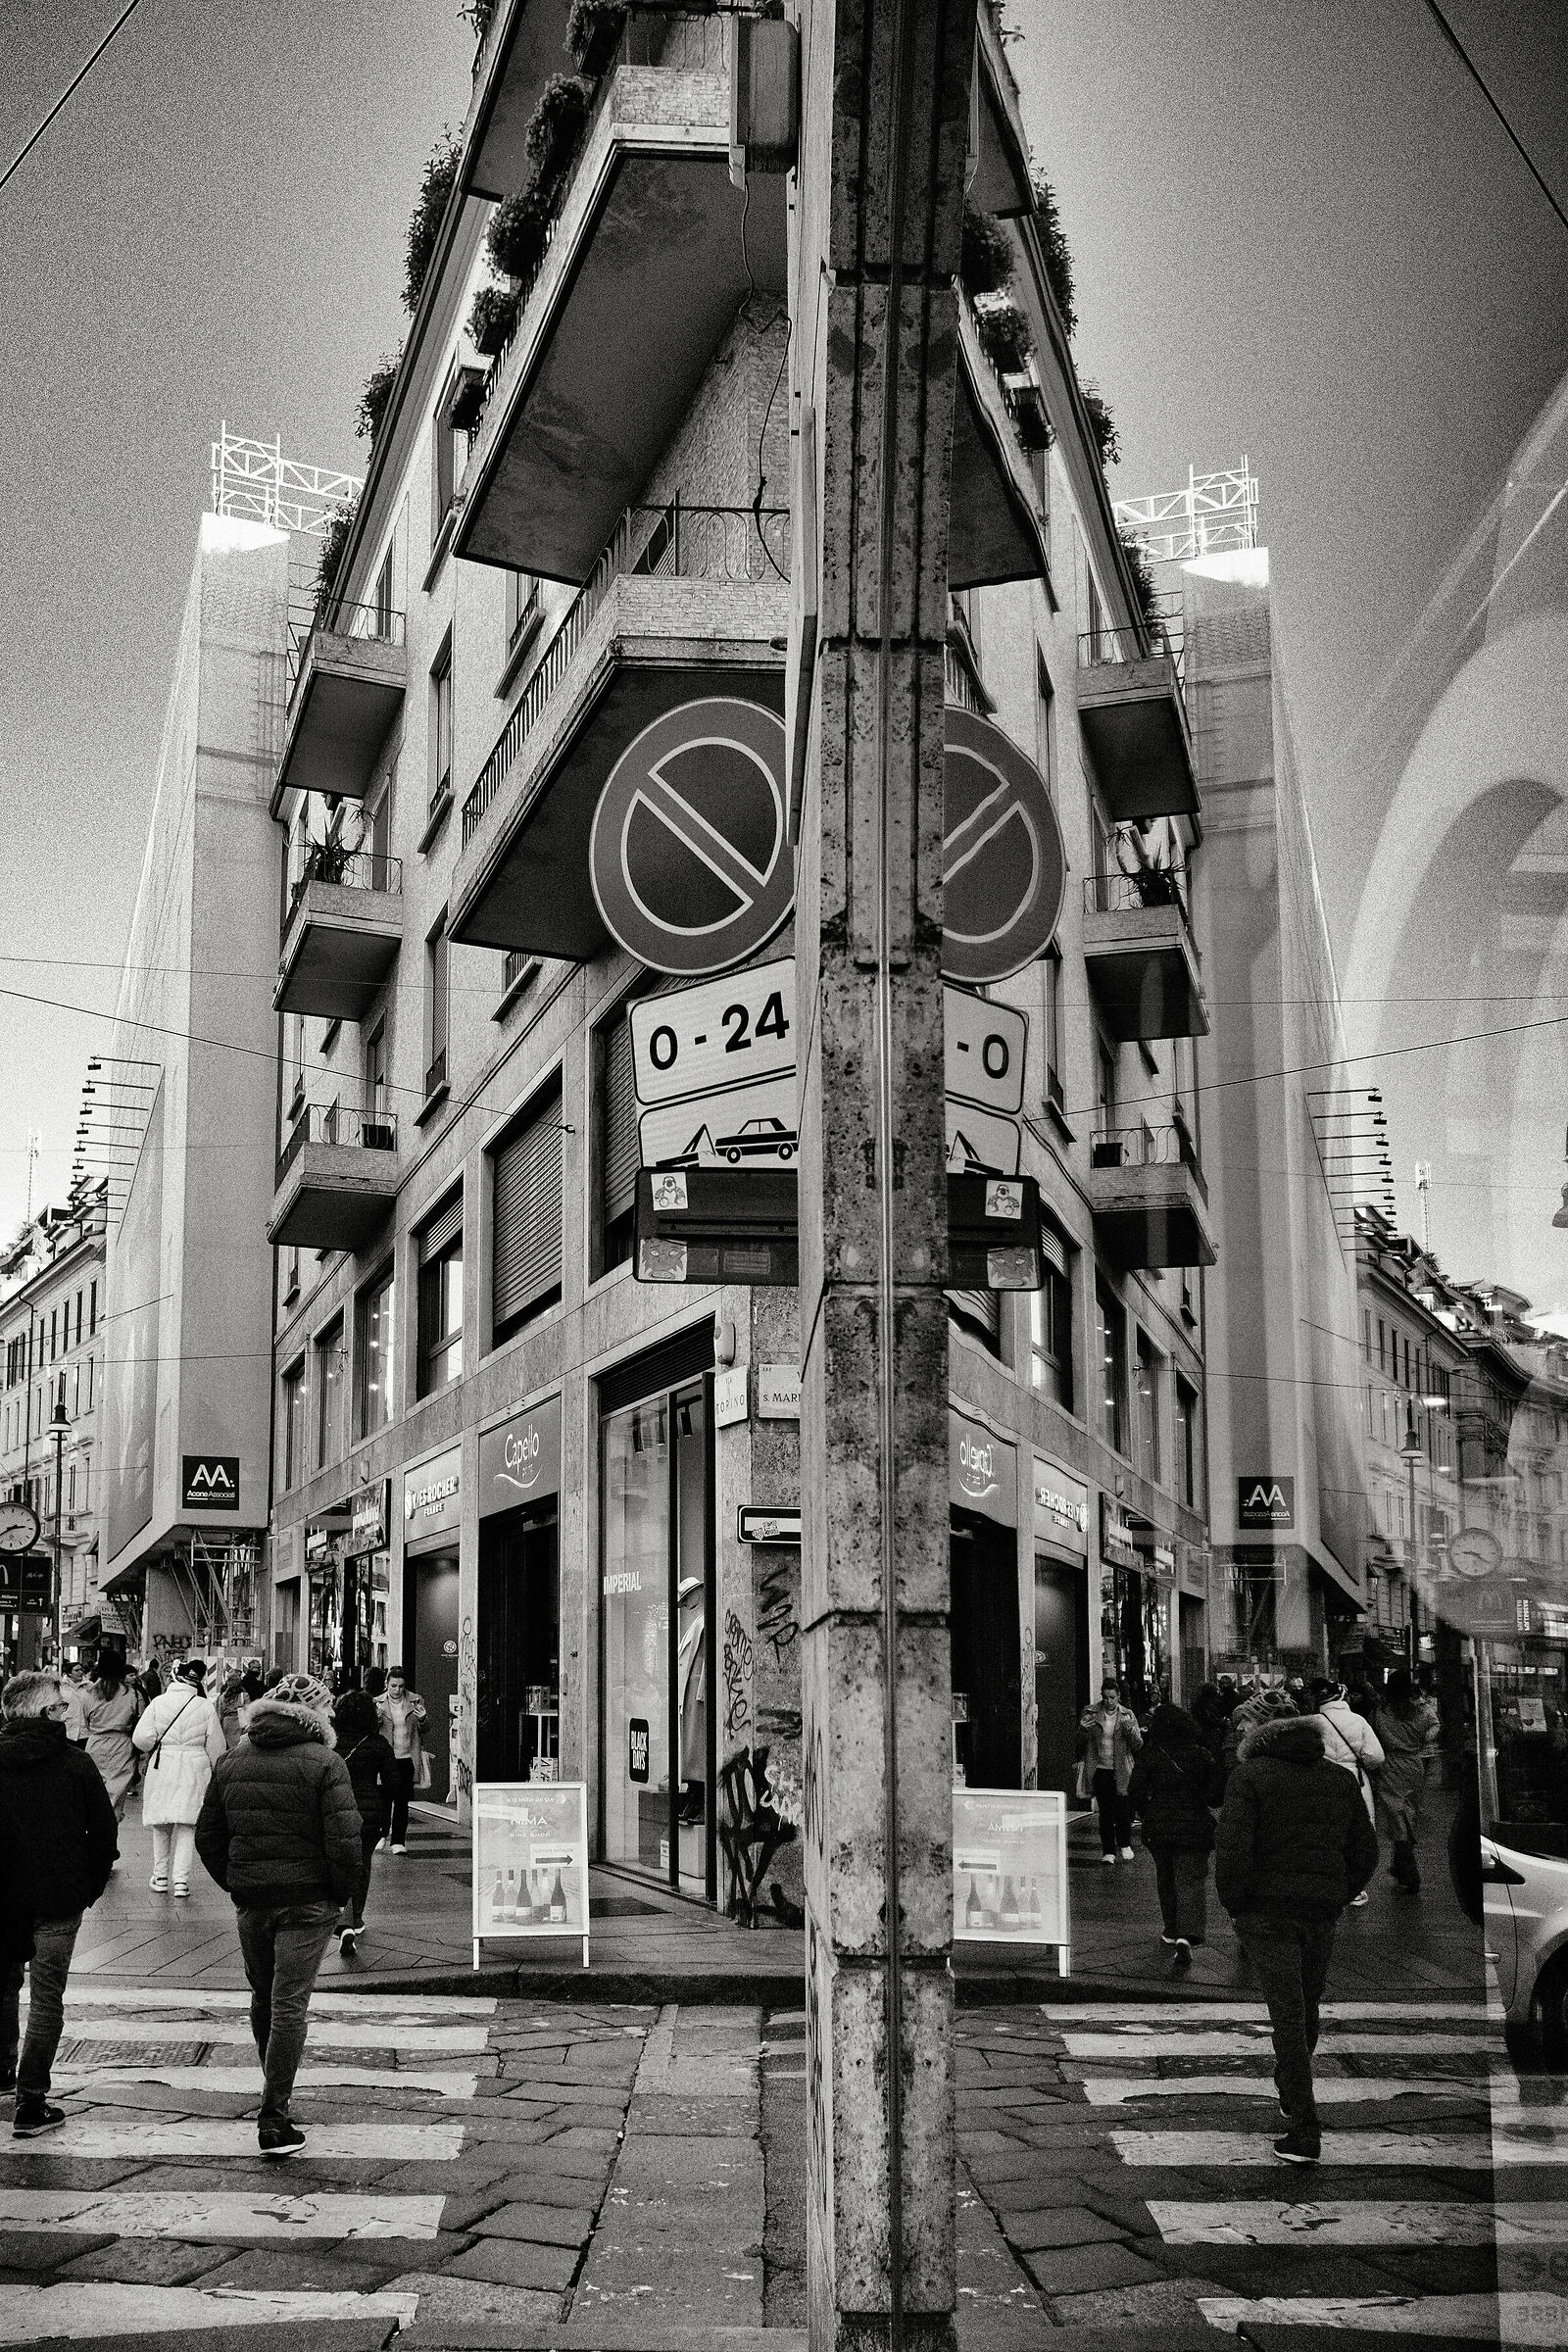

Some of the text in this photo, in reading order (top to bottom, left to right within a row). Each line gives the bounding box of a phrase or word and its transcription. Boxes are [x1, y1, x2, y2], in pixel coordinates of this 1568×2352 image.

[649, 1024, 678, 1070] 0
[721, 991, 790, 1053] 24
[716, 1394, 745, 1415] TORINO
[762, 1394, 769, 1402] S.
[505, 1423, 540, 1475] Capello
[427, 1475, 456, 1502] ROCHER
[603, 1571, 642, 1595] IMPERIAL
[630, 1731, 648, 1752] BLACK
[632, 1749, 646, 1770] DAYS
